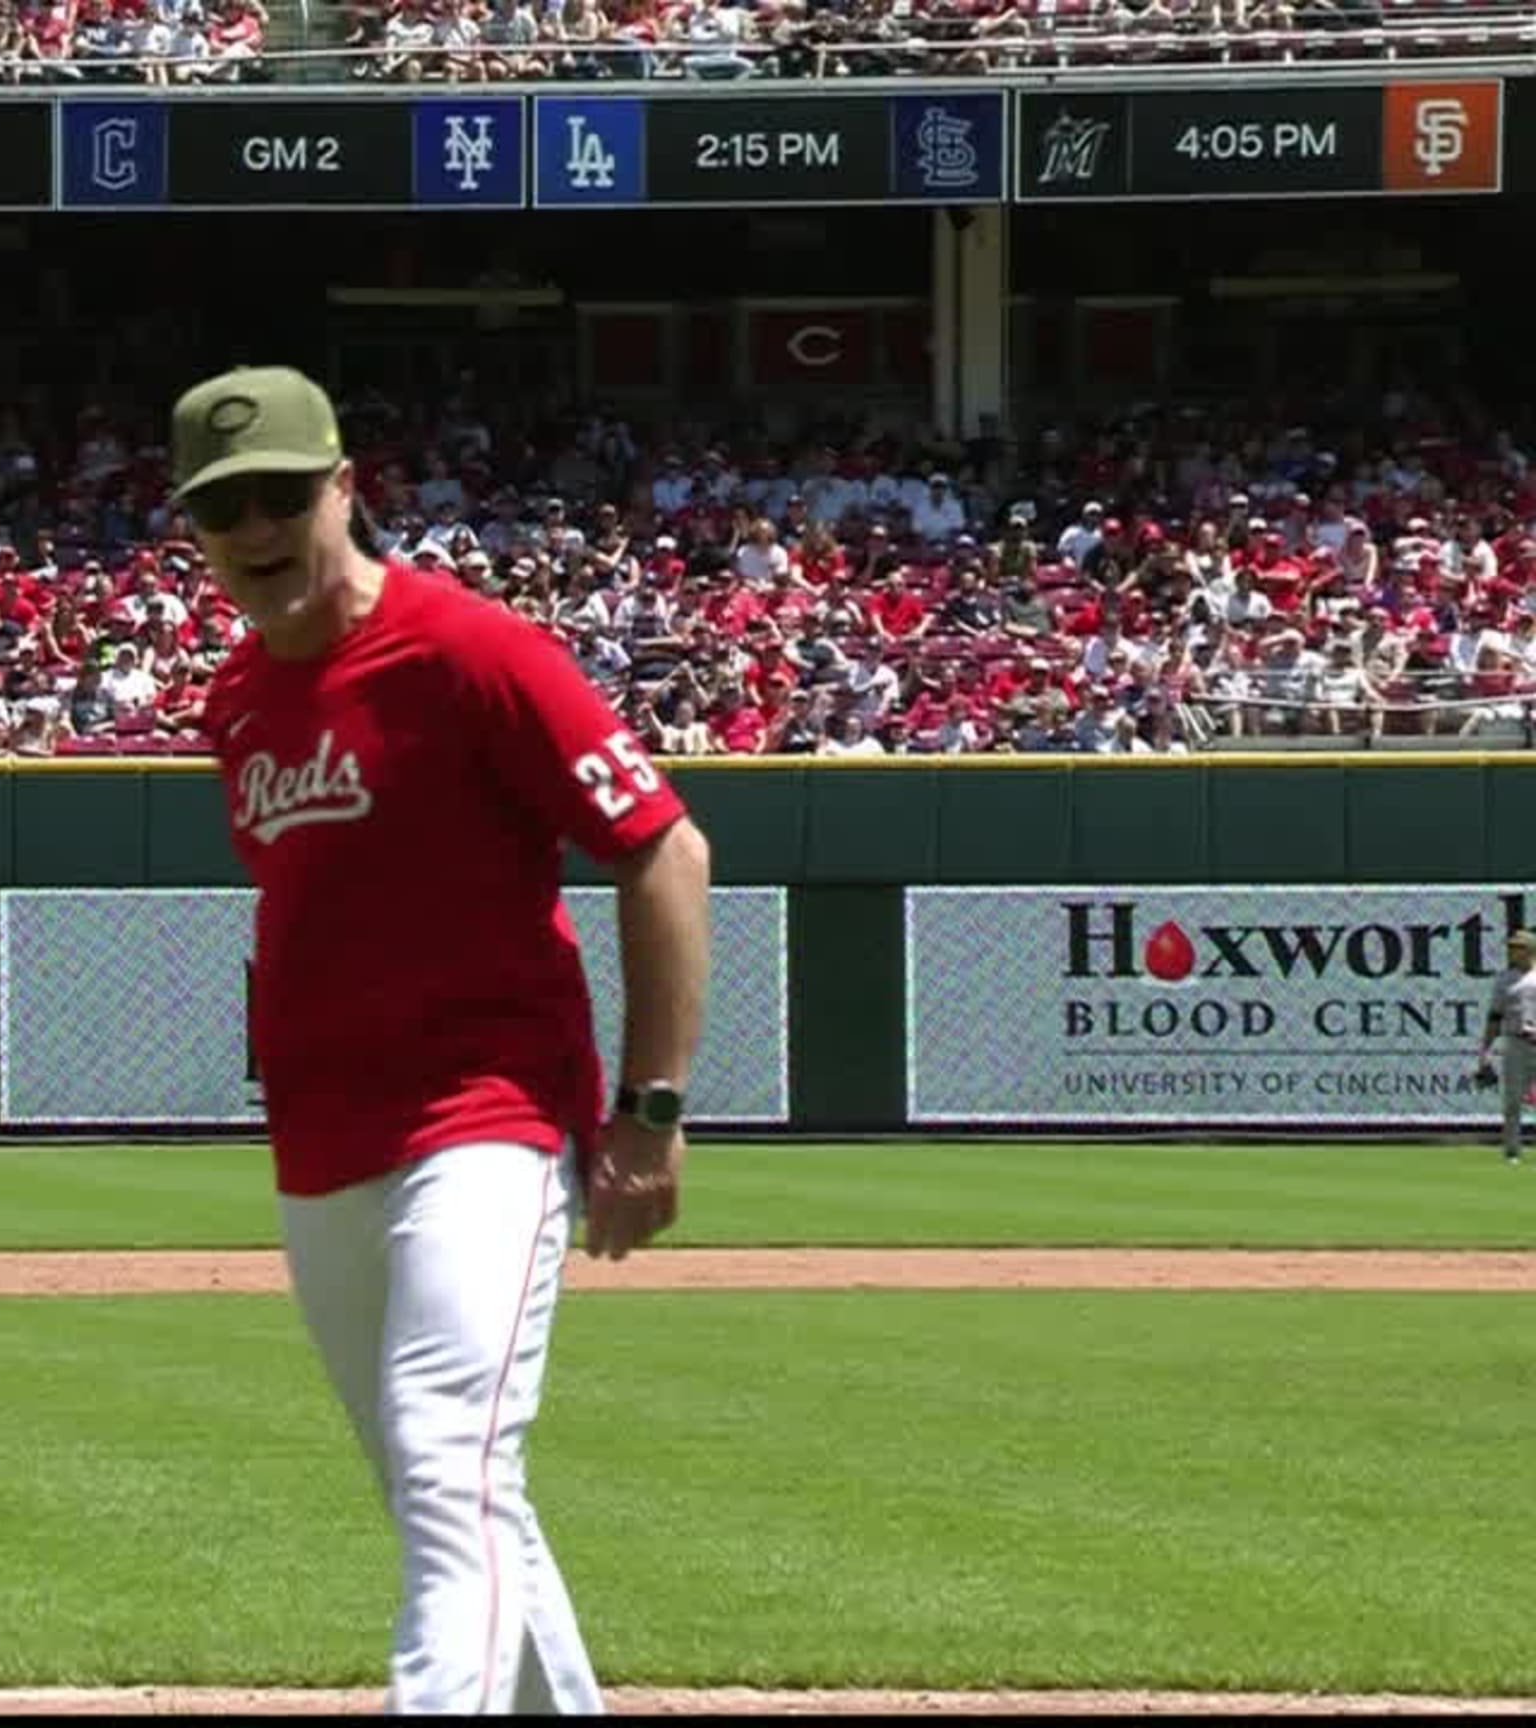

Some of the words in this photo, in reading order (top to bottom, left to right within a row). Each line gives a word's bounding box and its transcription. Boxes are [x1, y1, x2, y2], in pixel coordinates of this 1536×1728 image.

[242, 136, 307, 171] GM
[316, 136, 340, 171] 2
[697, 133, 769, 168] 2:15
[779, 132, 840, 166] PM
[1175, 124, 1263, 160] 4:05
[1274, 122, 1336, 157] PM
[234, 729, 372, 842] Reds
[575, 731, 659, 819] 25
[1065, 1000, 1276, 1038] BLOOD
[1315, 1000, 1479, 1038] CENT
[1065, 1072, 1247, 1096] UNIVERSITY
[1264, 1072, 1301, 1096] OF
[1315, 1072, 1500, 1096] CINCINNA
